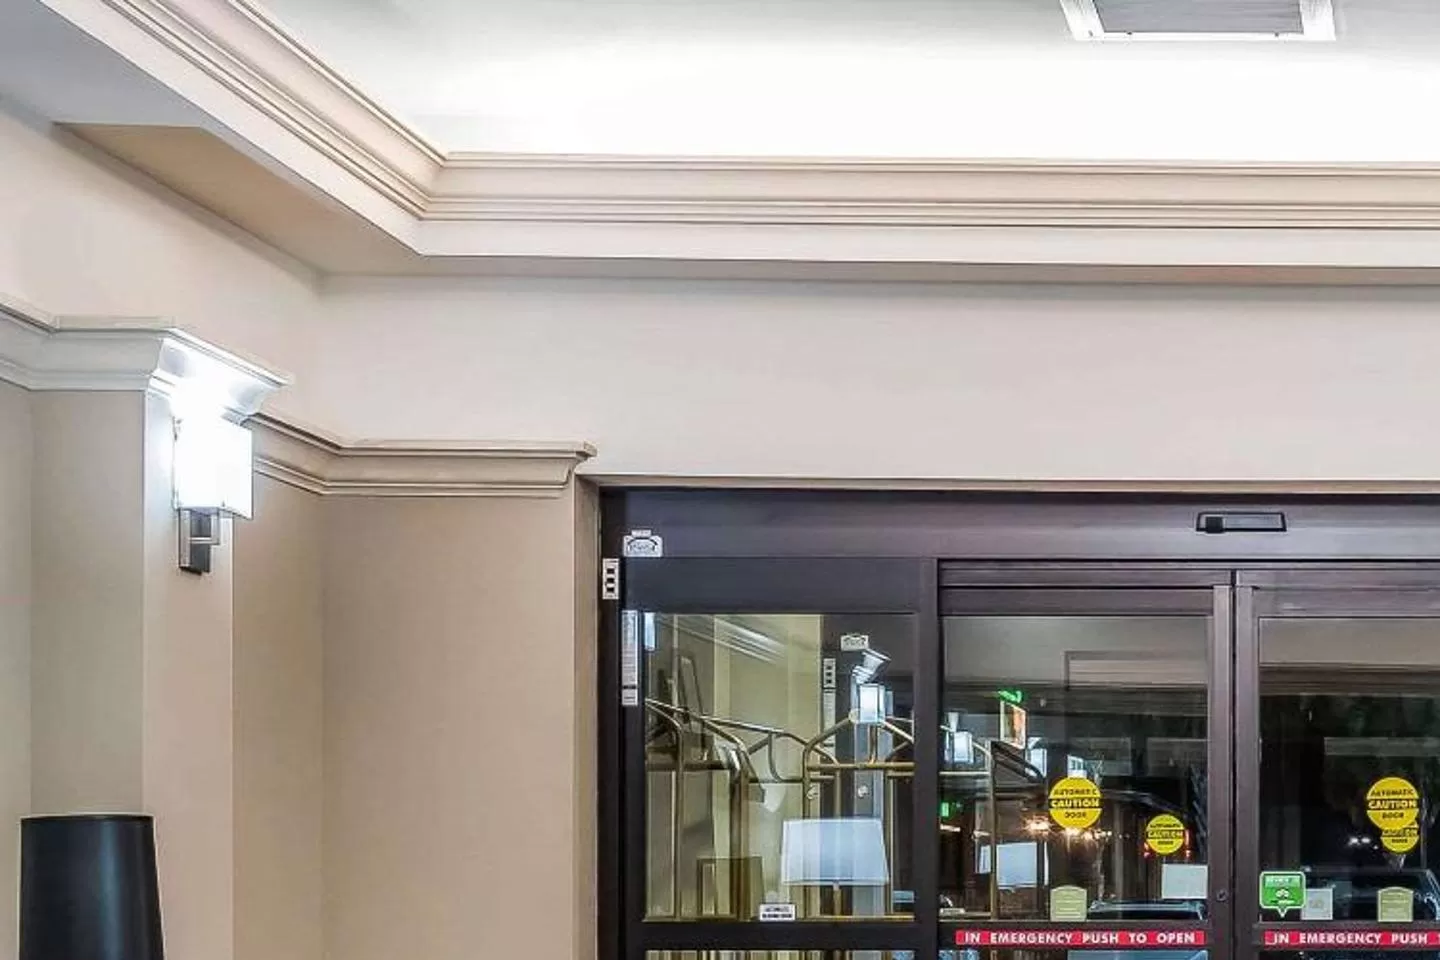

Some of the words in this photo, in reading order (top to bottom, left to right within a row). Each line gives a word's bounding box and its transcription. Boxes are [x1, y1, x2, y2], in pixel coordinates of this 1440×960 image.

[1054, 788, 1098, 796] AUTOMATIC
[1051, 799, 1100, 808] CAUTION
[1368, 799, 1417, 809] CAUTION
[1148, 831, 1183, 840] CAUTION
[964, 931, 980, 944] IN
[990, 931, 1073, 944] EMERGENCY
[1082, 931, 1119, 944] PUSH
[1129, 931, 1147, 944] TO
[1156, 931, 1195, 944] OPEN
[1273, 932, 1289, 945] IN
[1299, 932, 1381, 945] EMERGENCY
[1391, 932, 1428, 945] PUSH
